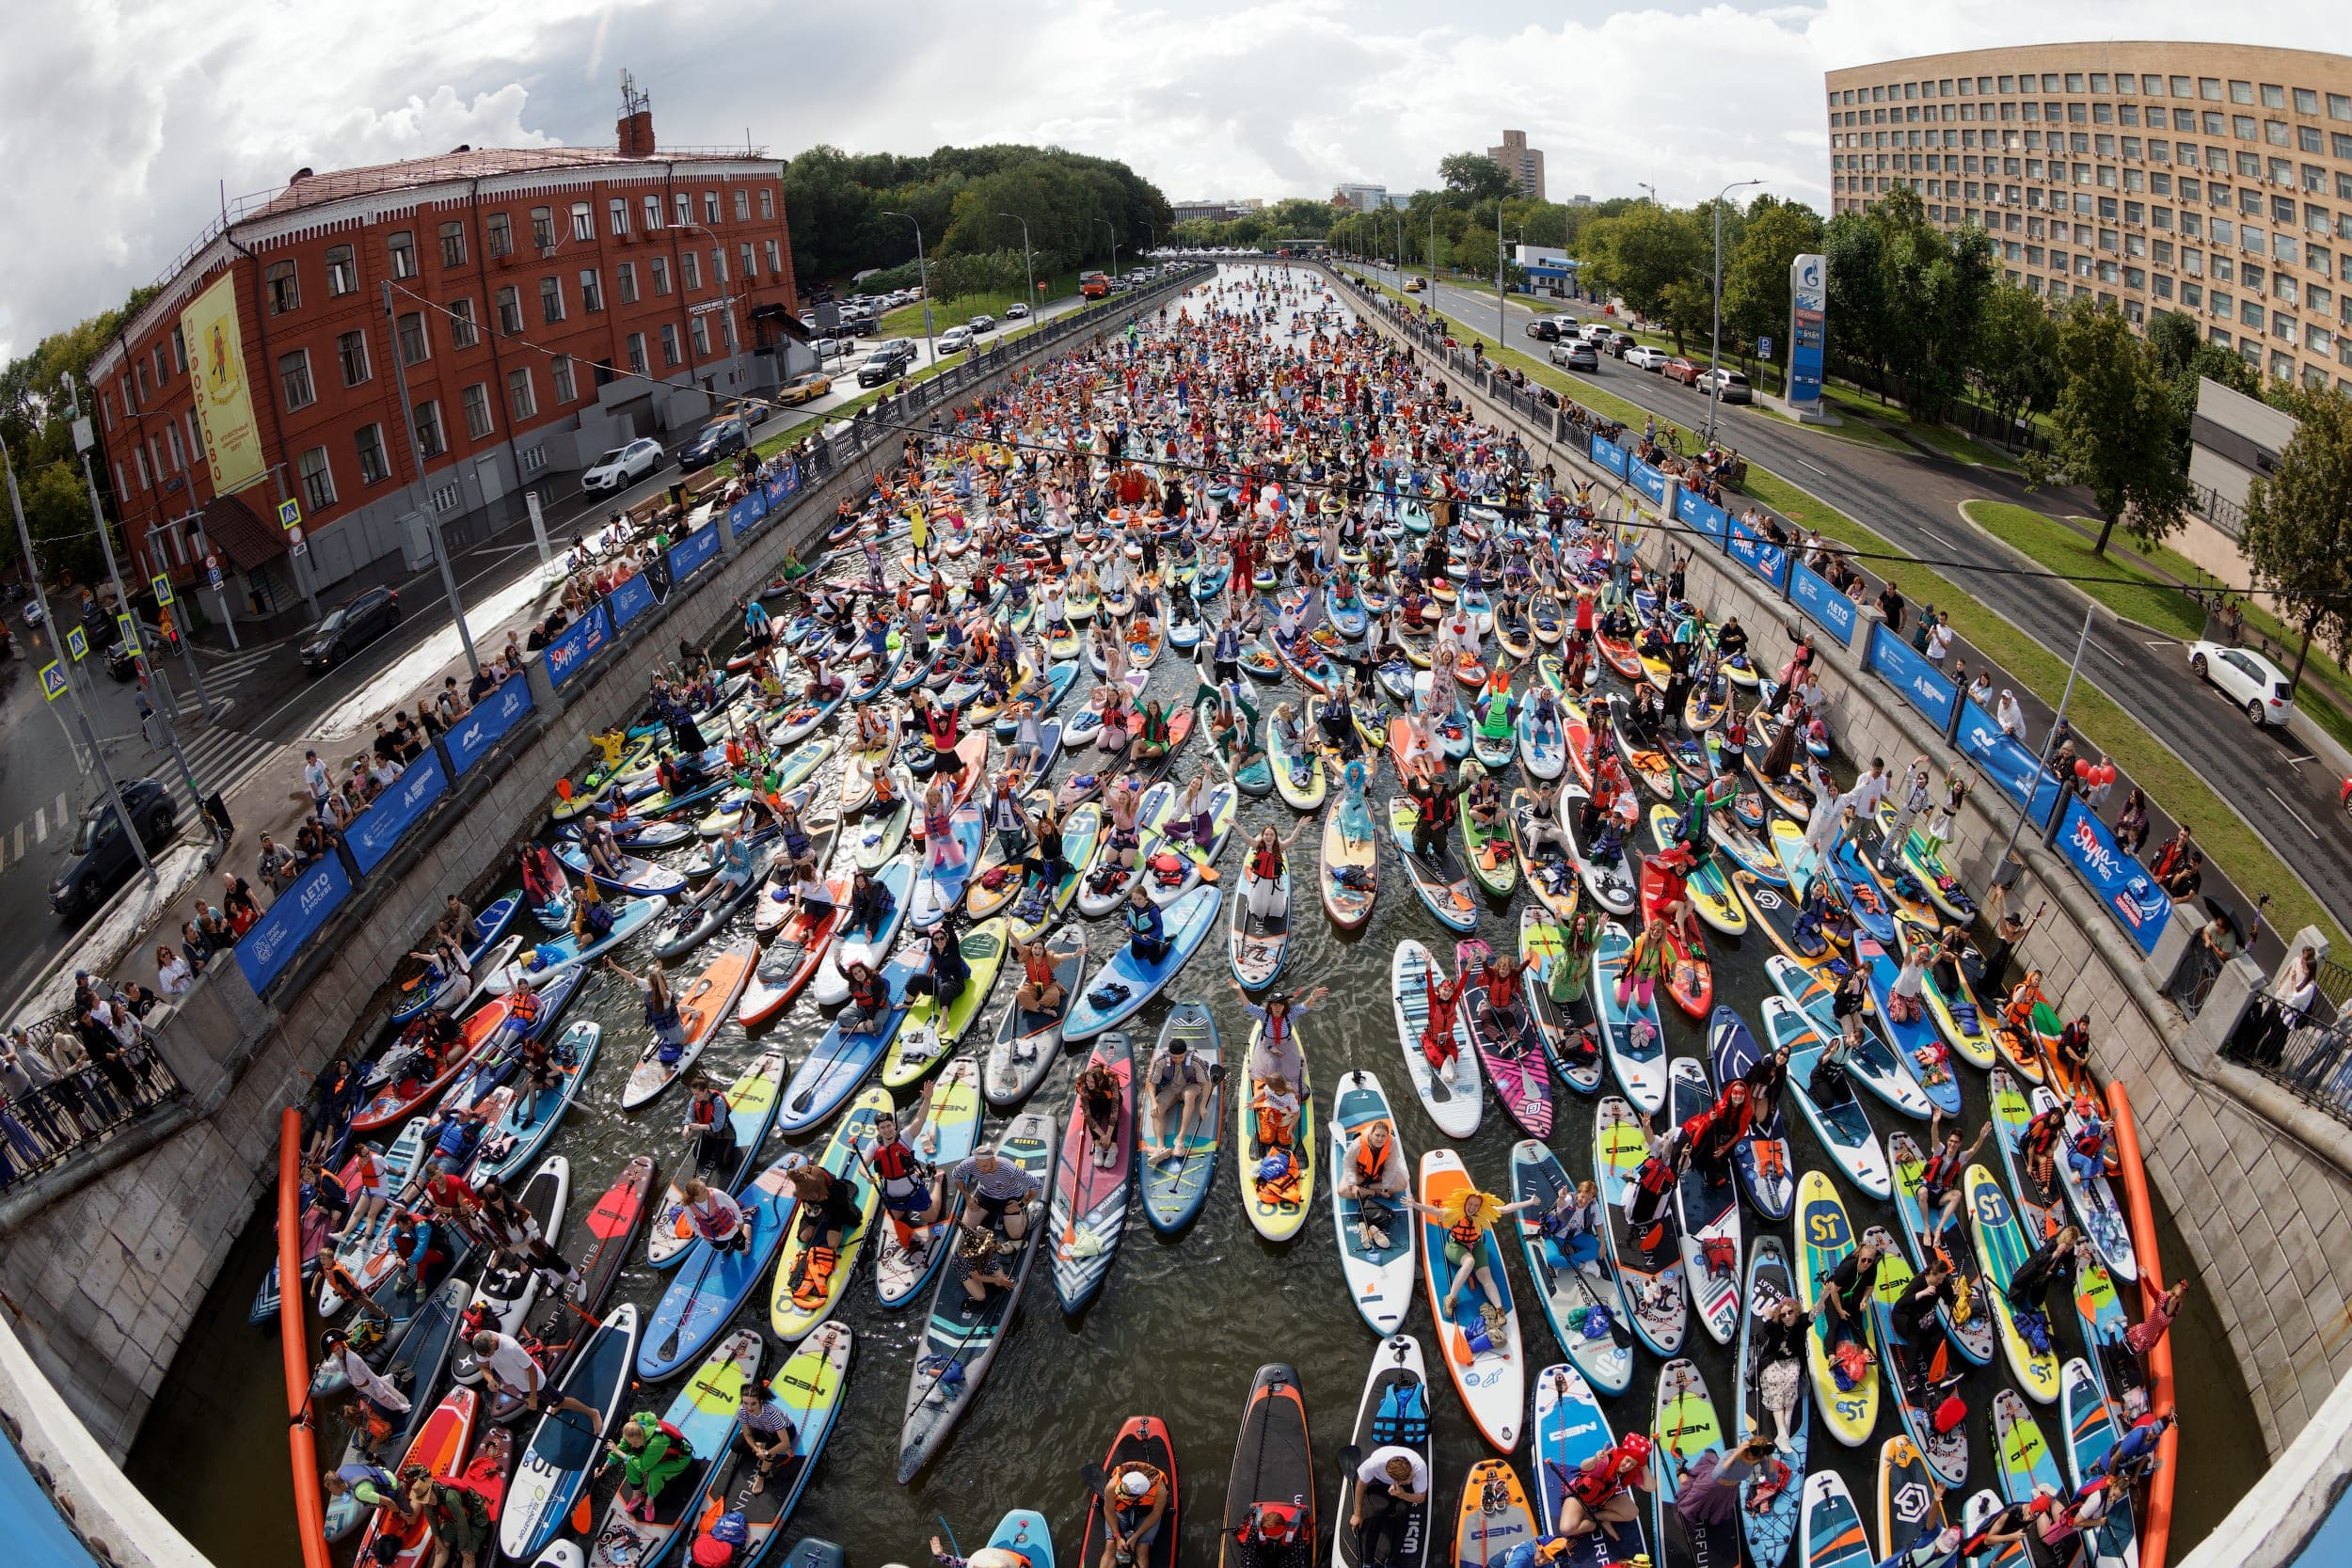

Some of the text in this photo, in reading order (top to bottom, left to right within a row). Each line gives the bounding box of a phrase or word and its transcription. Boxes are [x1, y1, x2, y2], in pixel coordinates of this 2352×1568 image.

[187, 318, 221, 481] ЛЕФОРТОВО
[1827, 599, 1849, 621] ЛЕТО
[300, 873, 328, 909] ЛЕТО
[309, 883, 332, 911] МОСКВЕ
[1605, 1145, 1643, 1154] NEO
[1095, 1184, 1127, 1214] GLADIATOR
[597, 1208, 628, 1224] NEO
[1879, 1276, 1910, 1291] NEO
[694, 1380, 734, 1404] NEO
[783, 1374, 826, 1397] NEO
[1549, 1421, 1597, 1442] NEO
[1666, 1423, 1710, 1438] NEO
[2010, 1438, 2039, 1464] NEO
[517, 1502, 539, 1541] GLADIATOR
[1470, 1524, 1523, 1541] NEO
